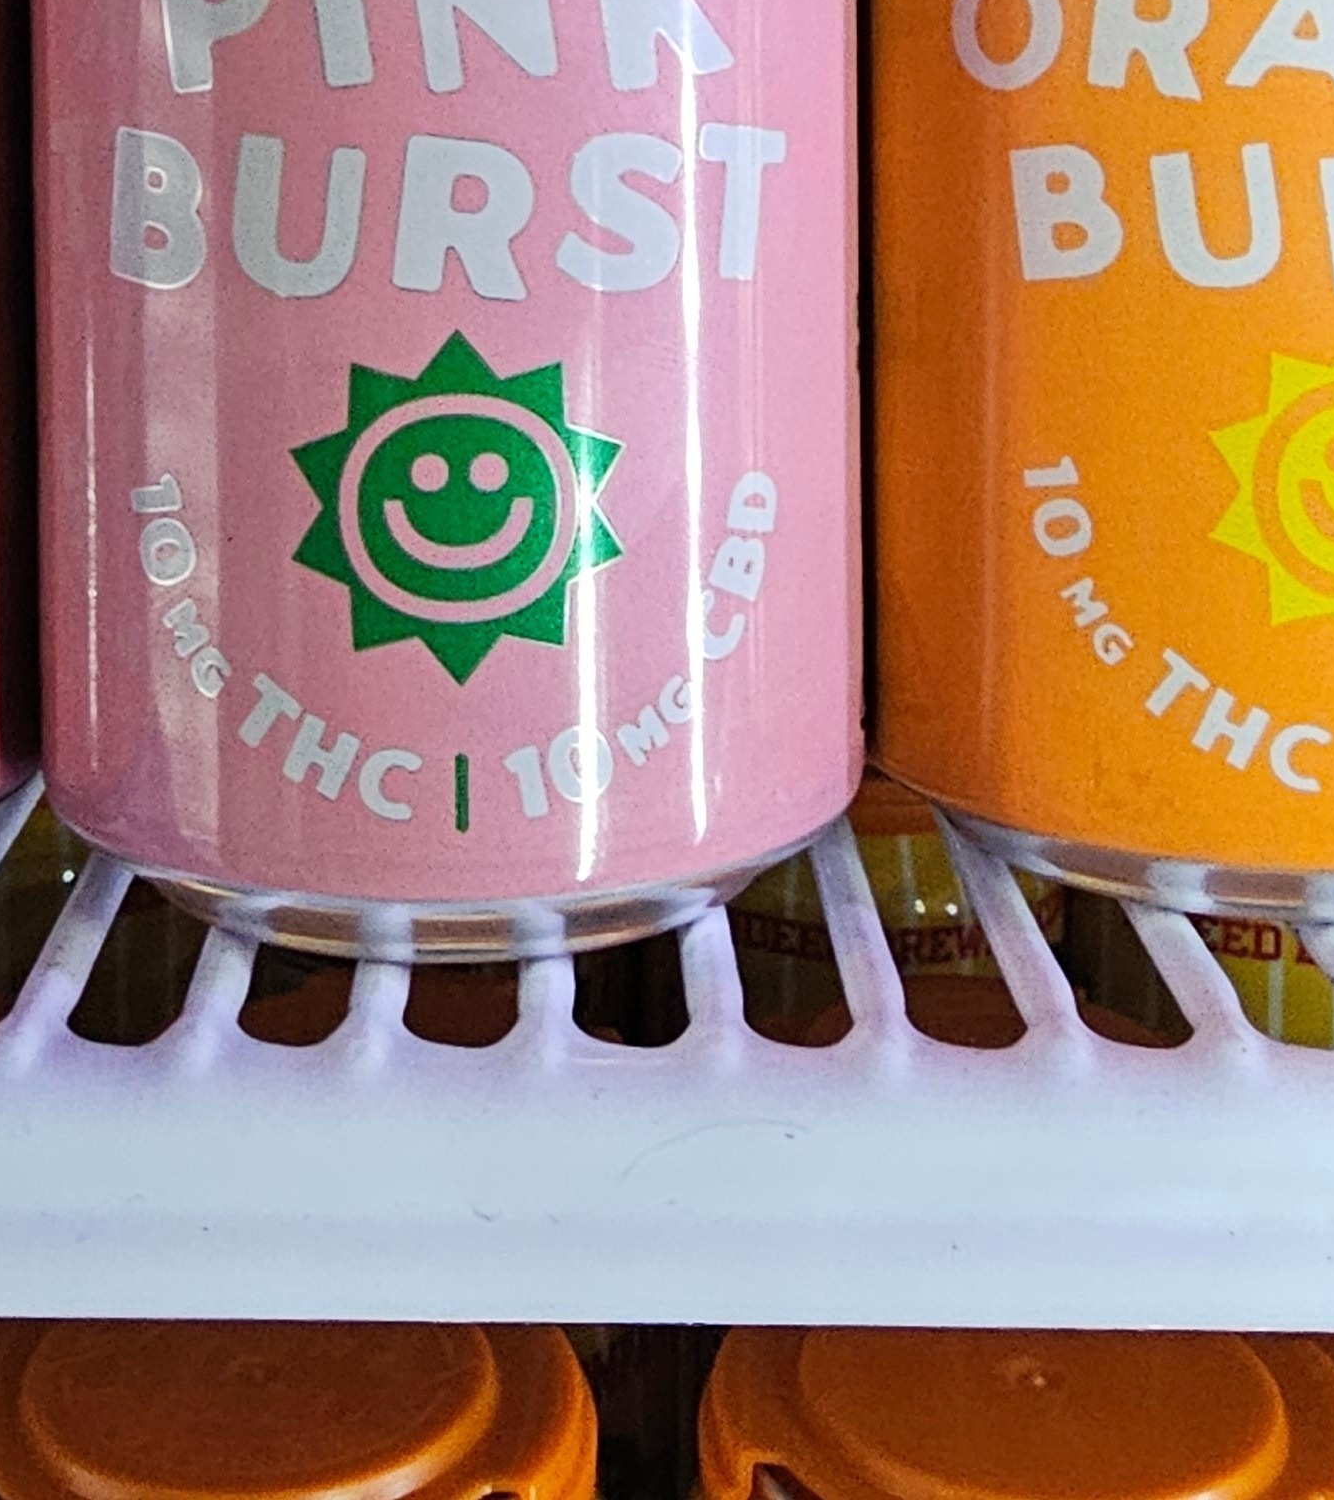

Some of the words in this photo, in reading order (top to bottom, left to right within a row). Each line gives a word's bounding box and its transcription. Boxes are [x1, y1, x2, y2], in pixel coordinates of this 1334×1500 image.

[109, 122, 787, 300] BURST
[238, 672, 423, 821] THC
[698, 470, 778, 661] CBD
[1144, 648, 1333, 793] THC
